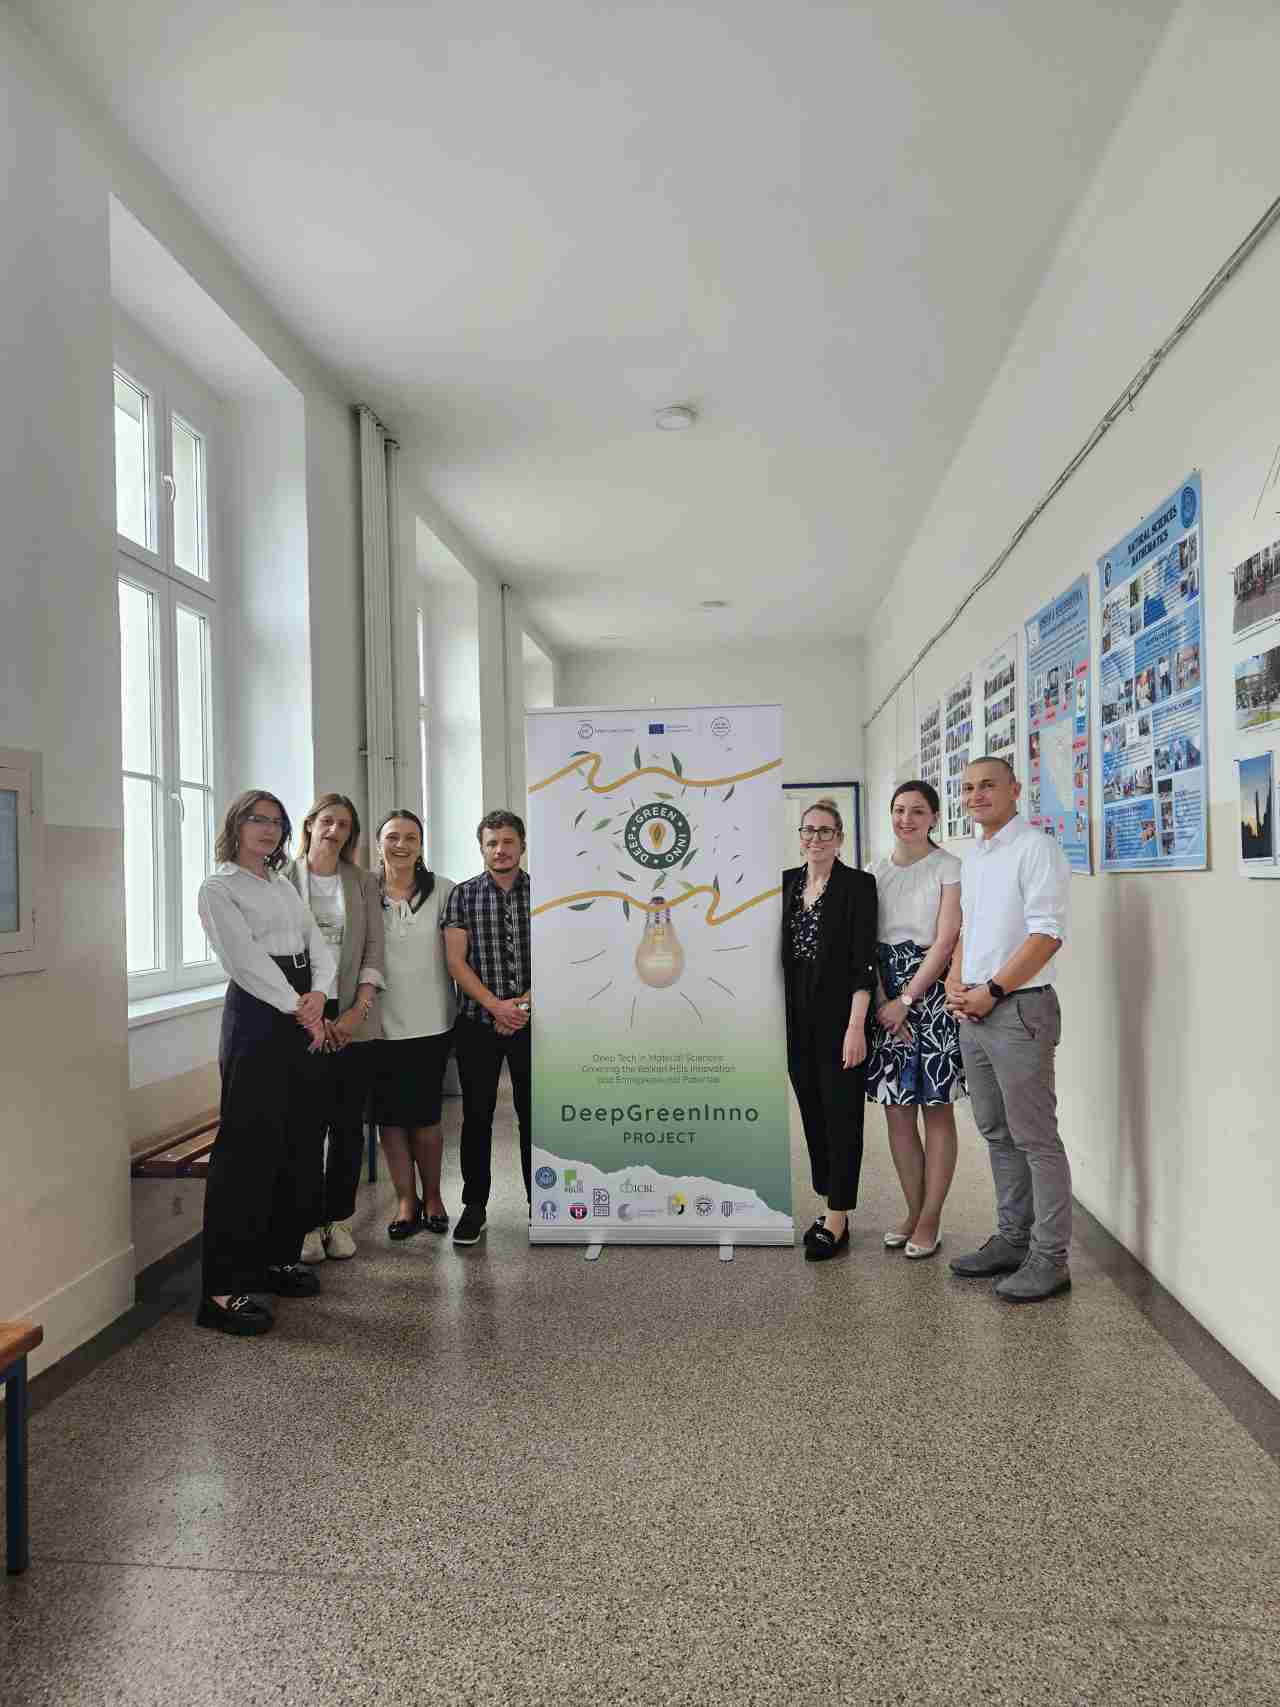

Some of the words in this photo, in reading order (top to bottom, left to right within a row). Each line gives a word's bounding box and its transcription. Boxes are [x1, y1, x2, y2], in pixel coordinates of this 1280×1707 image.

[635, 806, 677, 824] GREEN
[628, 833, 649, 863] DEEP
[665, 833, 687, 863] INNO
[561, 1104, 760, 1127] DeepGreenInno
[623, 1131, 697, 1144] PROJECT
